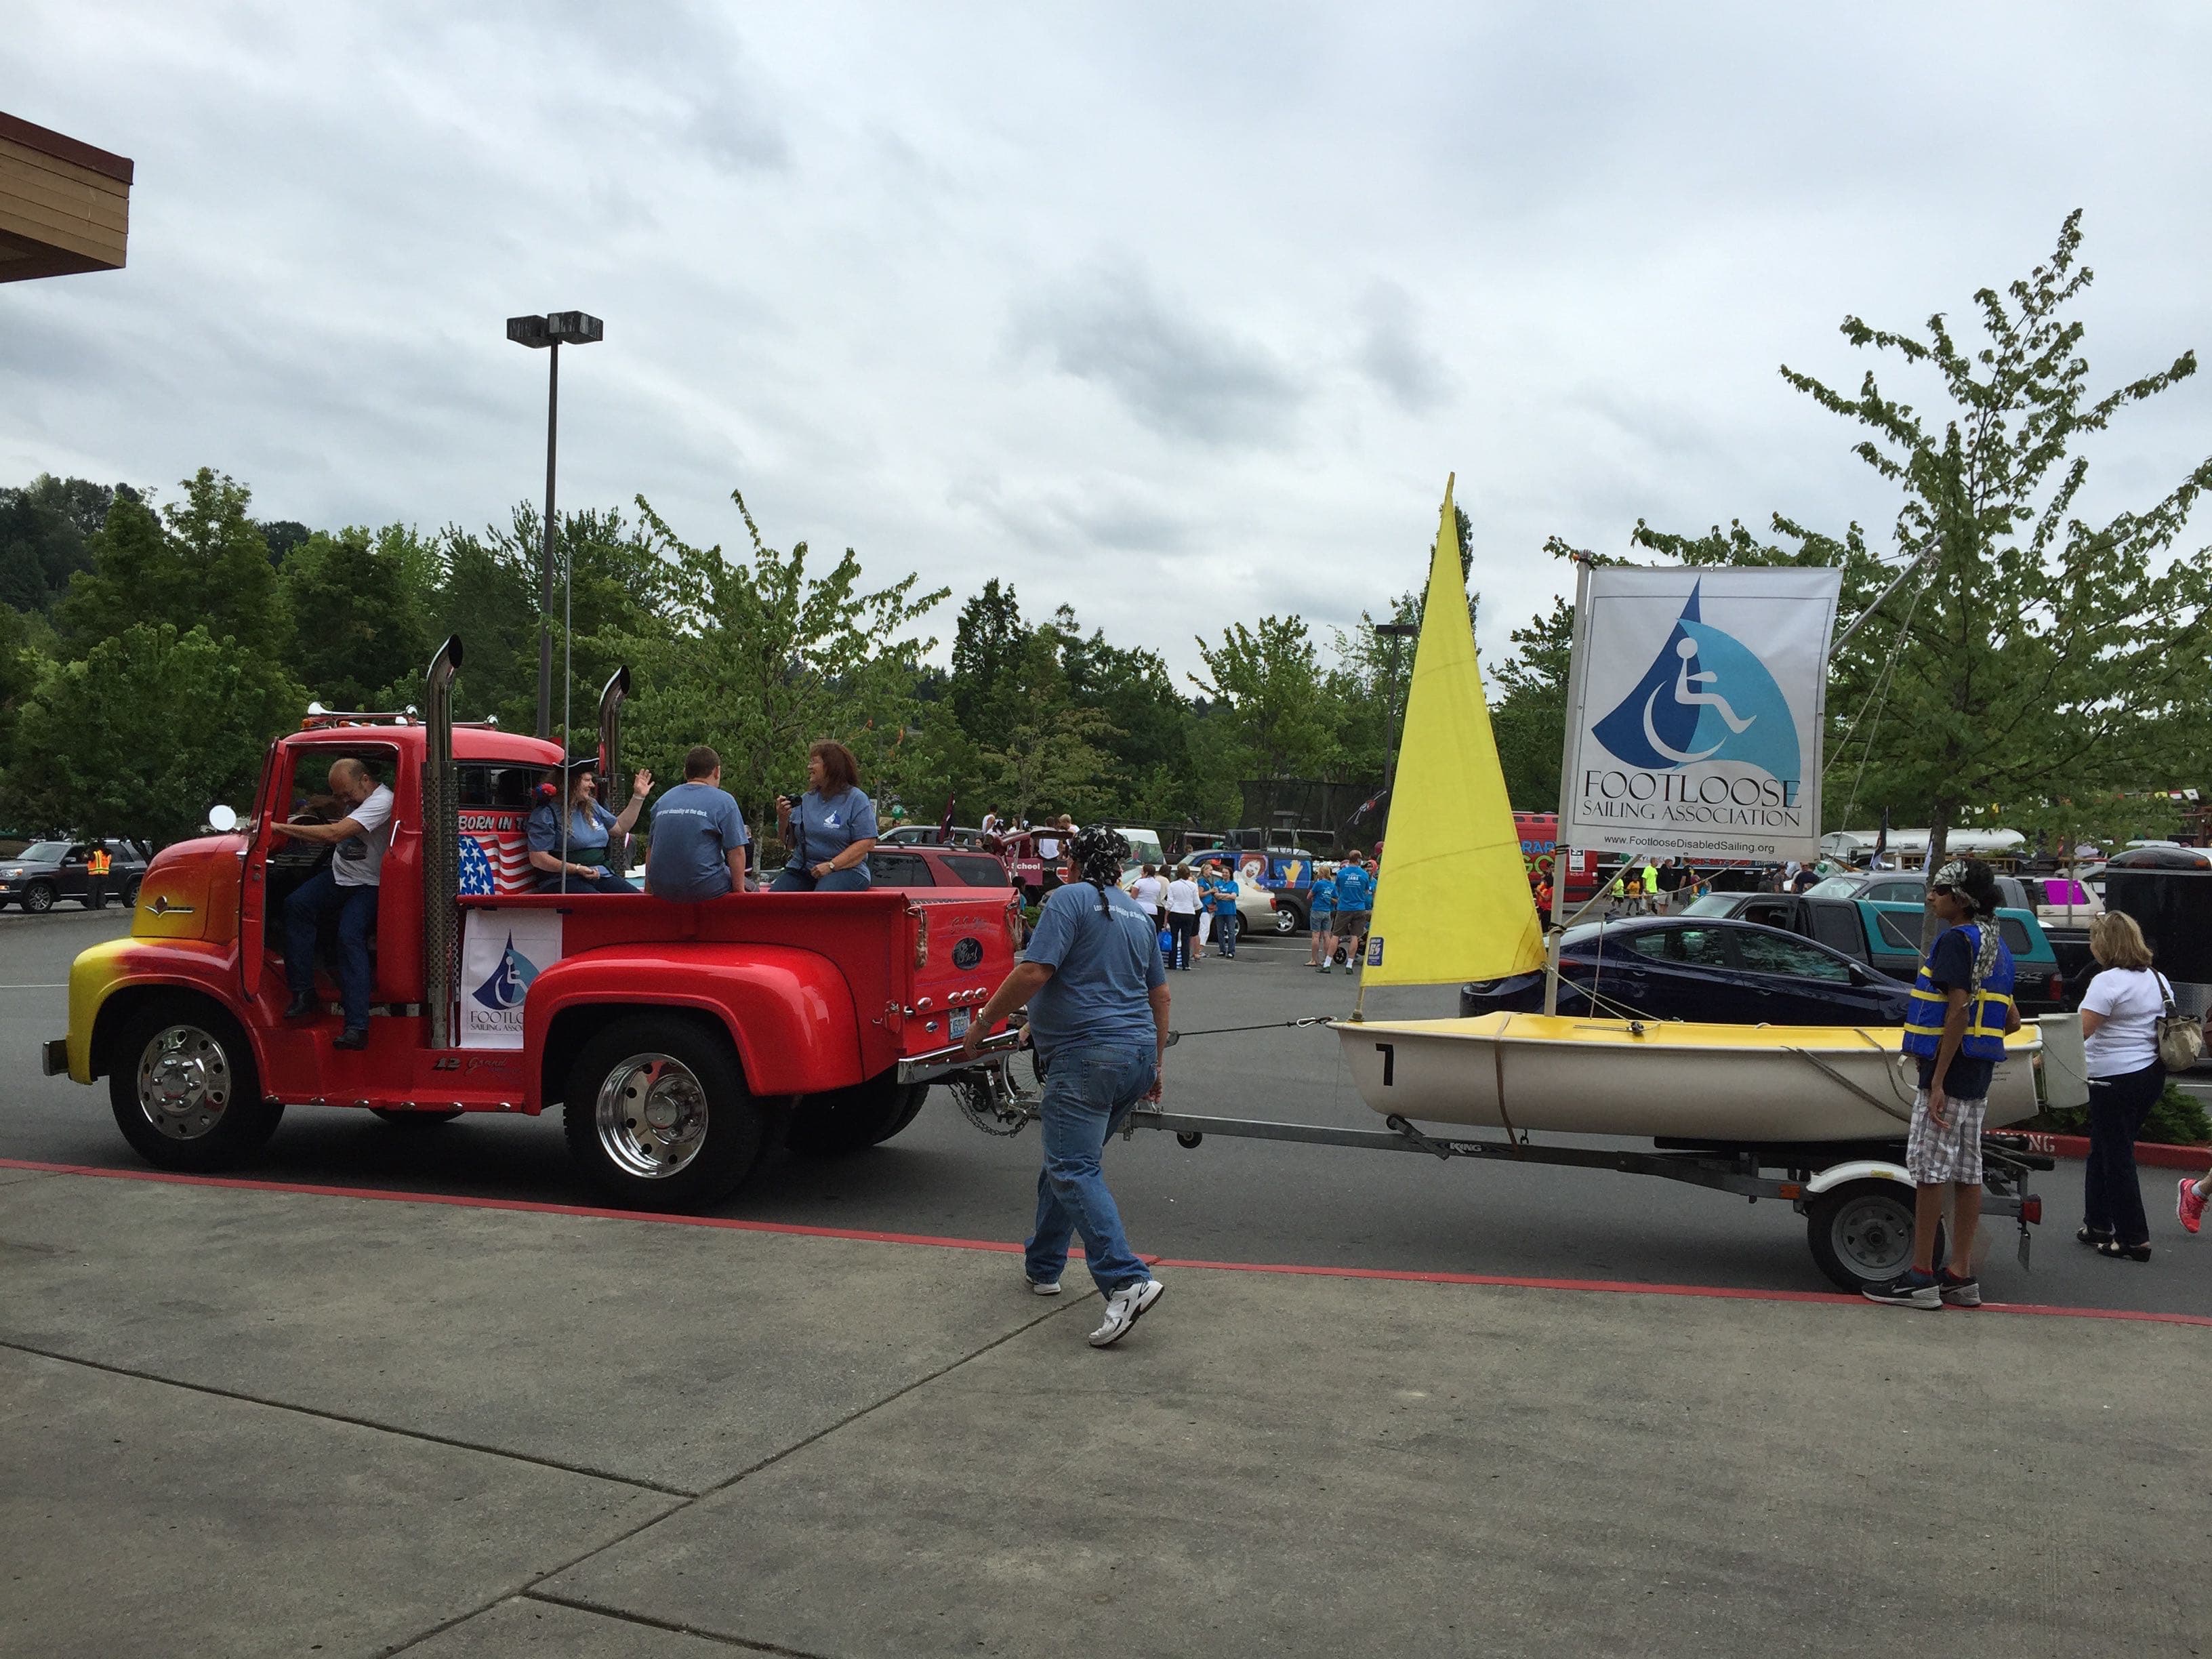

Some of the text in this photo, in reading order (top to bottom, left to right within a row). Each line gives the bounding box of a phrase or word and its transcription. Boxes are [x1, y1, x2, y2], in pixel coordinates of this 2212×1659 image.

[1584, 770, 1802, 808] FOOTLOOSE
[458, 815, 494, 830] BORN
[498, 816, 512, 830] IN
[1582, 800, 1800, 827] SAILING ASSOCIATION
[1604, 835, 1775, 855] www.FootlooseDisabledSailing.org
[1376, 1044, 1394, 1086] 7
[1450, 1142, 1482, 1154] KING
